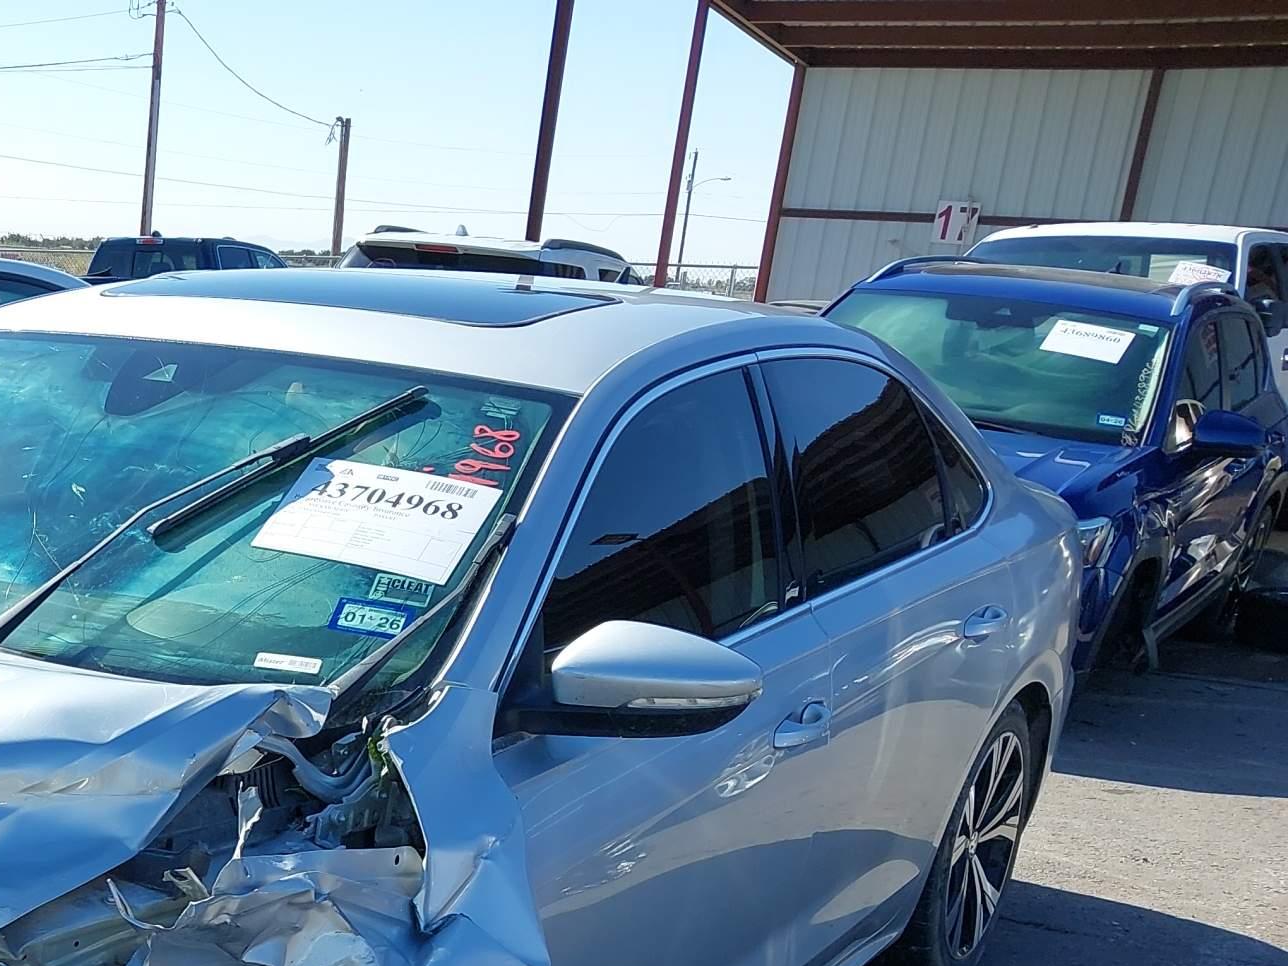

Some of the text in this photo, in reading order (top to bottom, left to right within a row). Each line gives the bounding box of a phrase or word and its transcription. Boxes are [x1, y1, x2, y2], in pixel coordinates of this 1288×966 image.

[938, 205, 979, 241] 17
[311, 479, 463, 520] 43704968
[343, 611, 402, 631] 01 26
